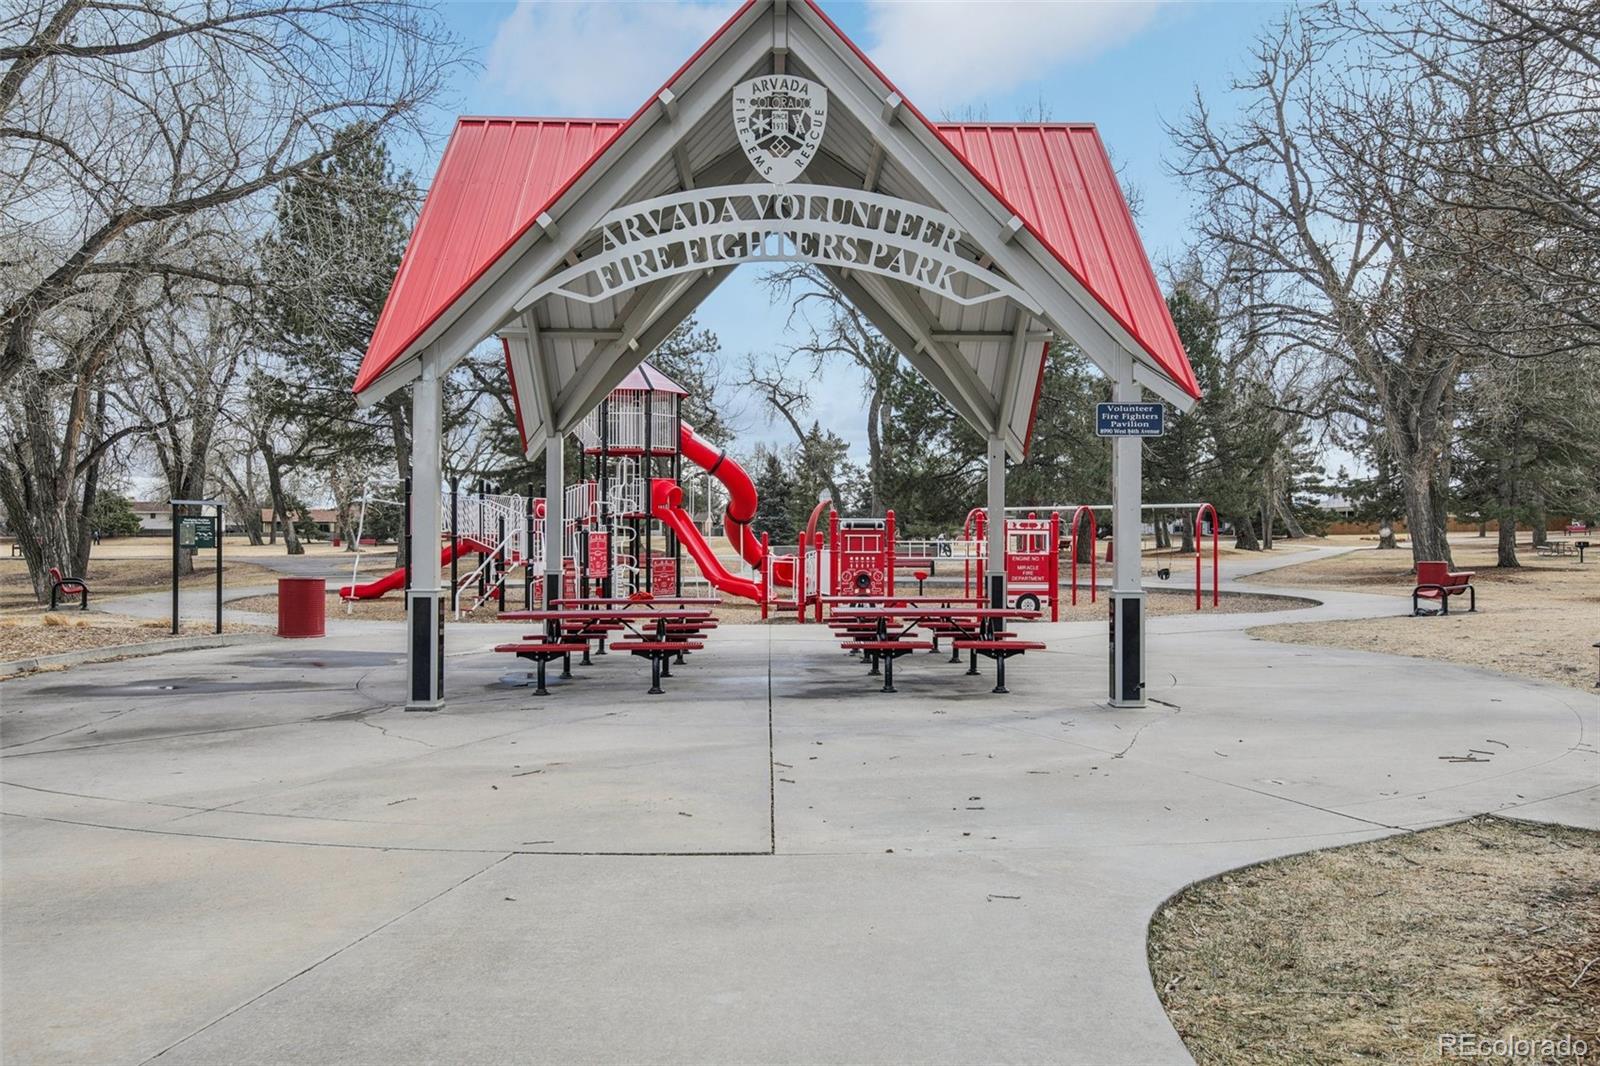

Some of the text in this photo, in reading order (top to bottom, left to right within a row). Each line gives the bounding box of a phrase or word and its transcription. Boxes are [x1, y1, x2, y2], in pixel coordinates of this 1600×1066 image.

[749, 98, 812, 109] COLORADO
[752, 78, 809, 95] ARVADA
[794, 109, 824, 168] RESCUE
[600, 194, 963, 256] ARVADA VOLUNTEER
[599, 231, 962, 294] FIRE FIGHTERS PARK
[1122, 413, 1158, 421] Fighters
